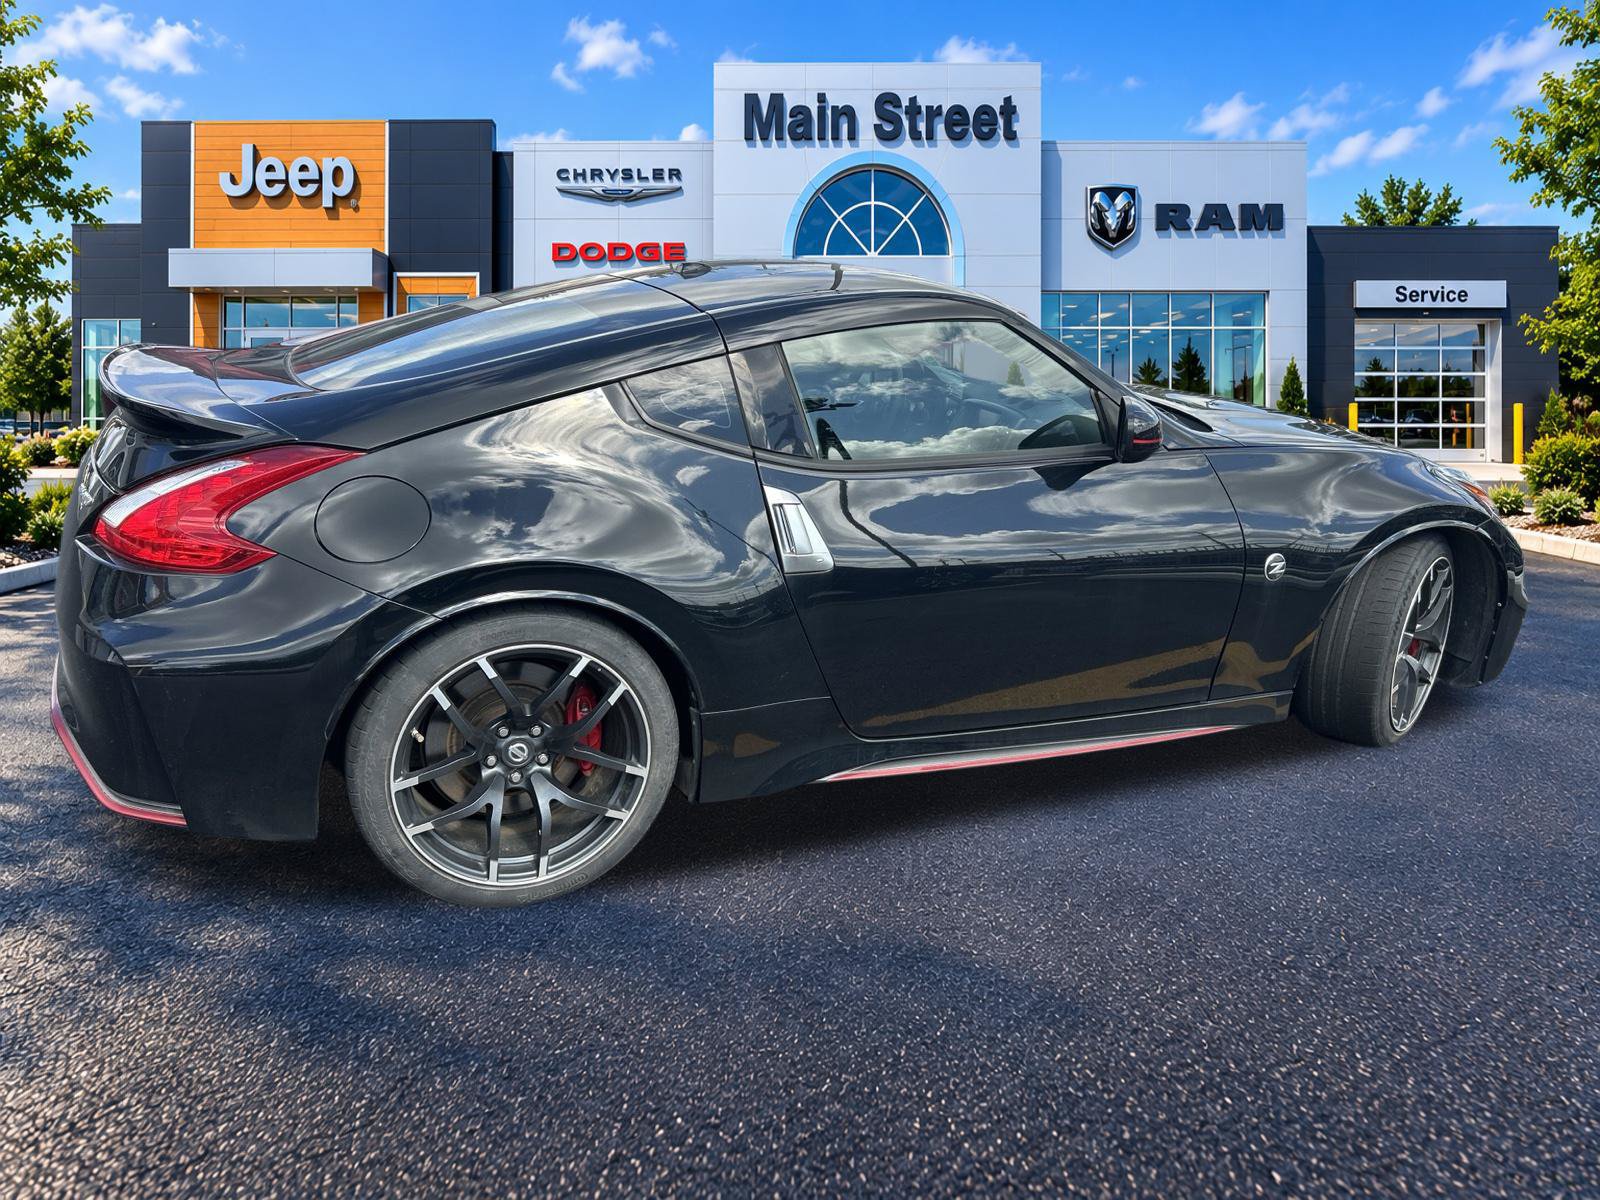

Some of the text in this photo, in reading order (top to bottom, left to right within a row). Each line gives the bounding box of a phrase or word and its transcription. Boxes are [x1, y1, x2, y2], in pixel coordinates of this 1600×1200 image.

[744, 92, 1018, 142] Main Street
[219, 144, 354, 208] Jeep
[556, 168, 682, 182] CHRYSLER
[1155, 203, 1283, 231] RAM
[552, 242, 686, 262] DODGE
[1395, 285, 1469, 303] Service
